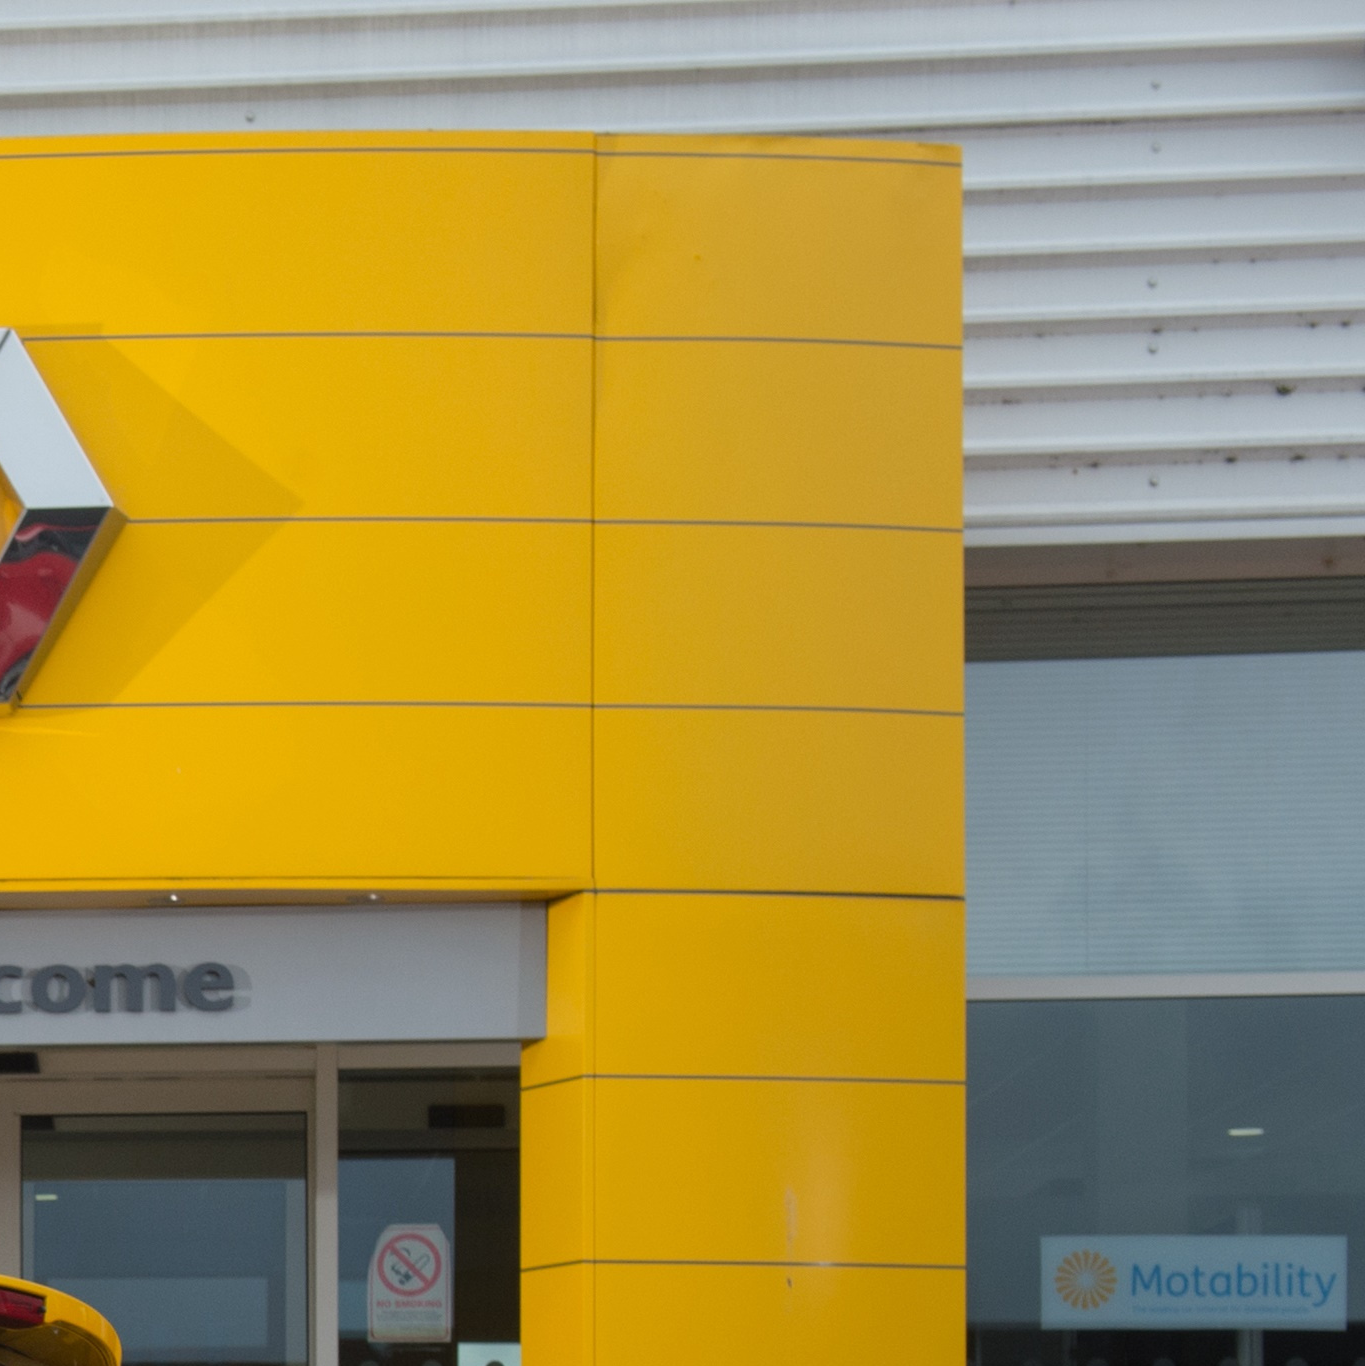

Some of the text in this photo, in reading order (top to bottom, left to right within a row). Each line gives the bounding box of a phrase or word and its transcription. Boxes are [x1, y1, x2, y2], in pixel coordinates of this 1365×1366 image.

[1130, 1262, 1337, 1308] Motability
[376, 1300, 442, 1308] NO SMOKING
